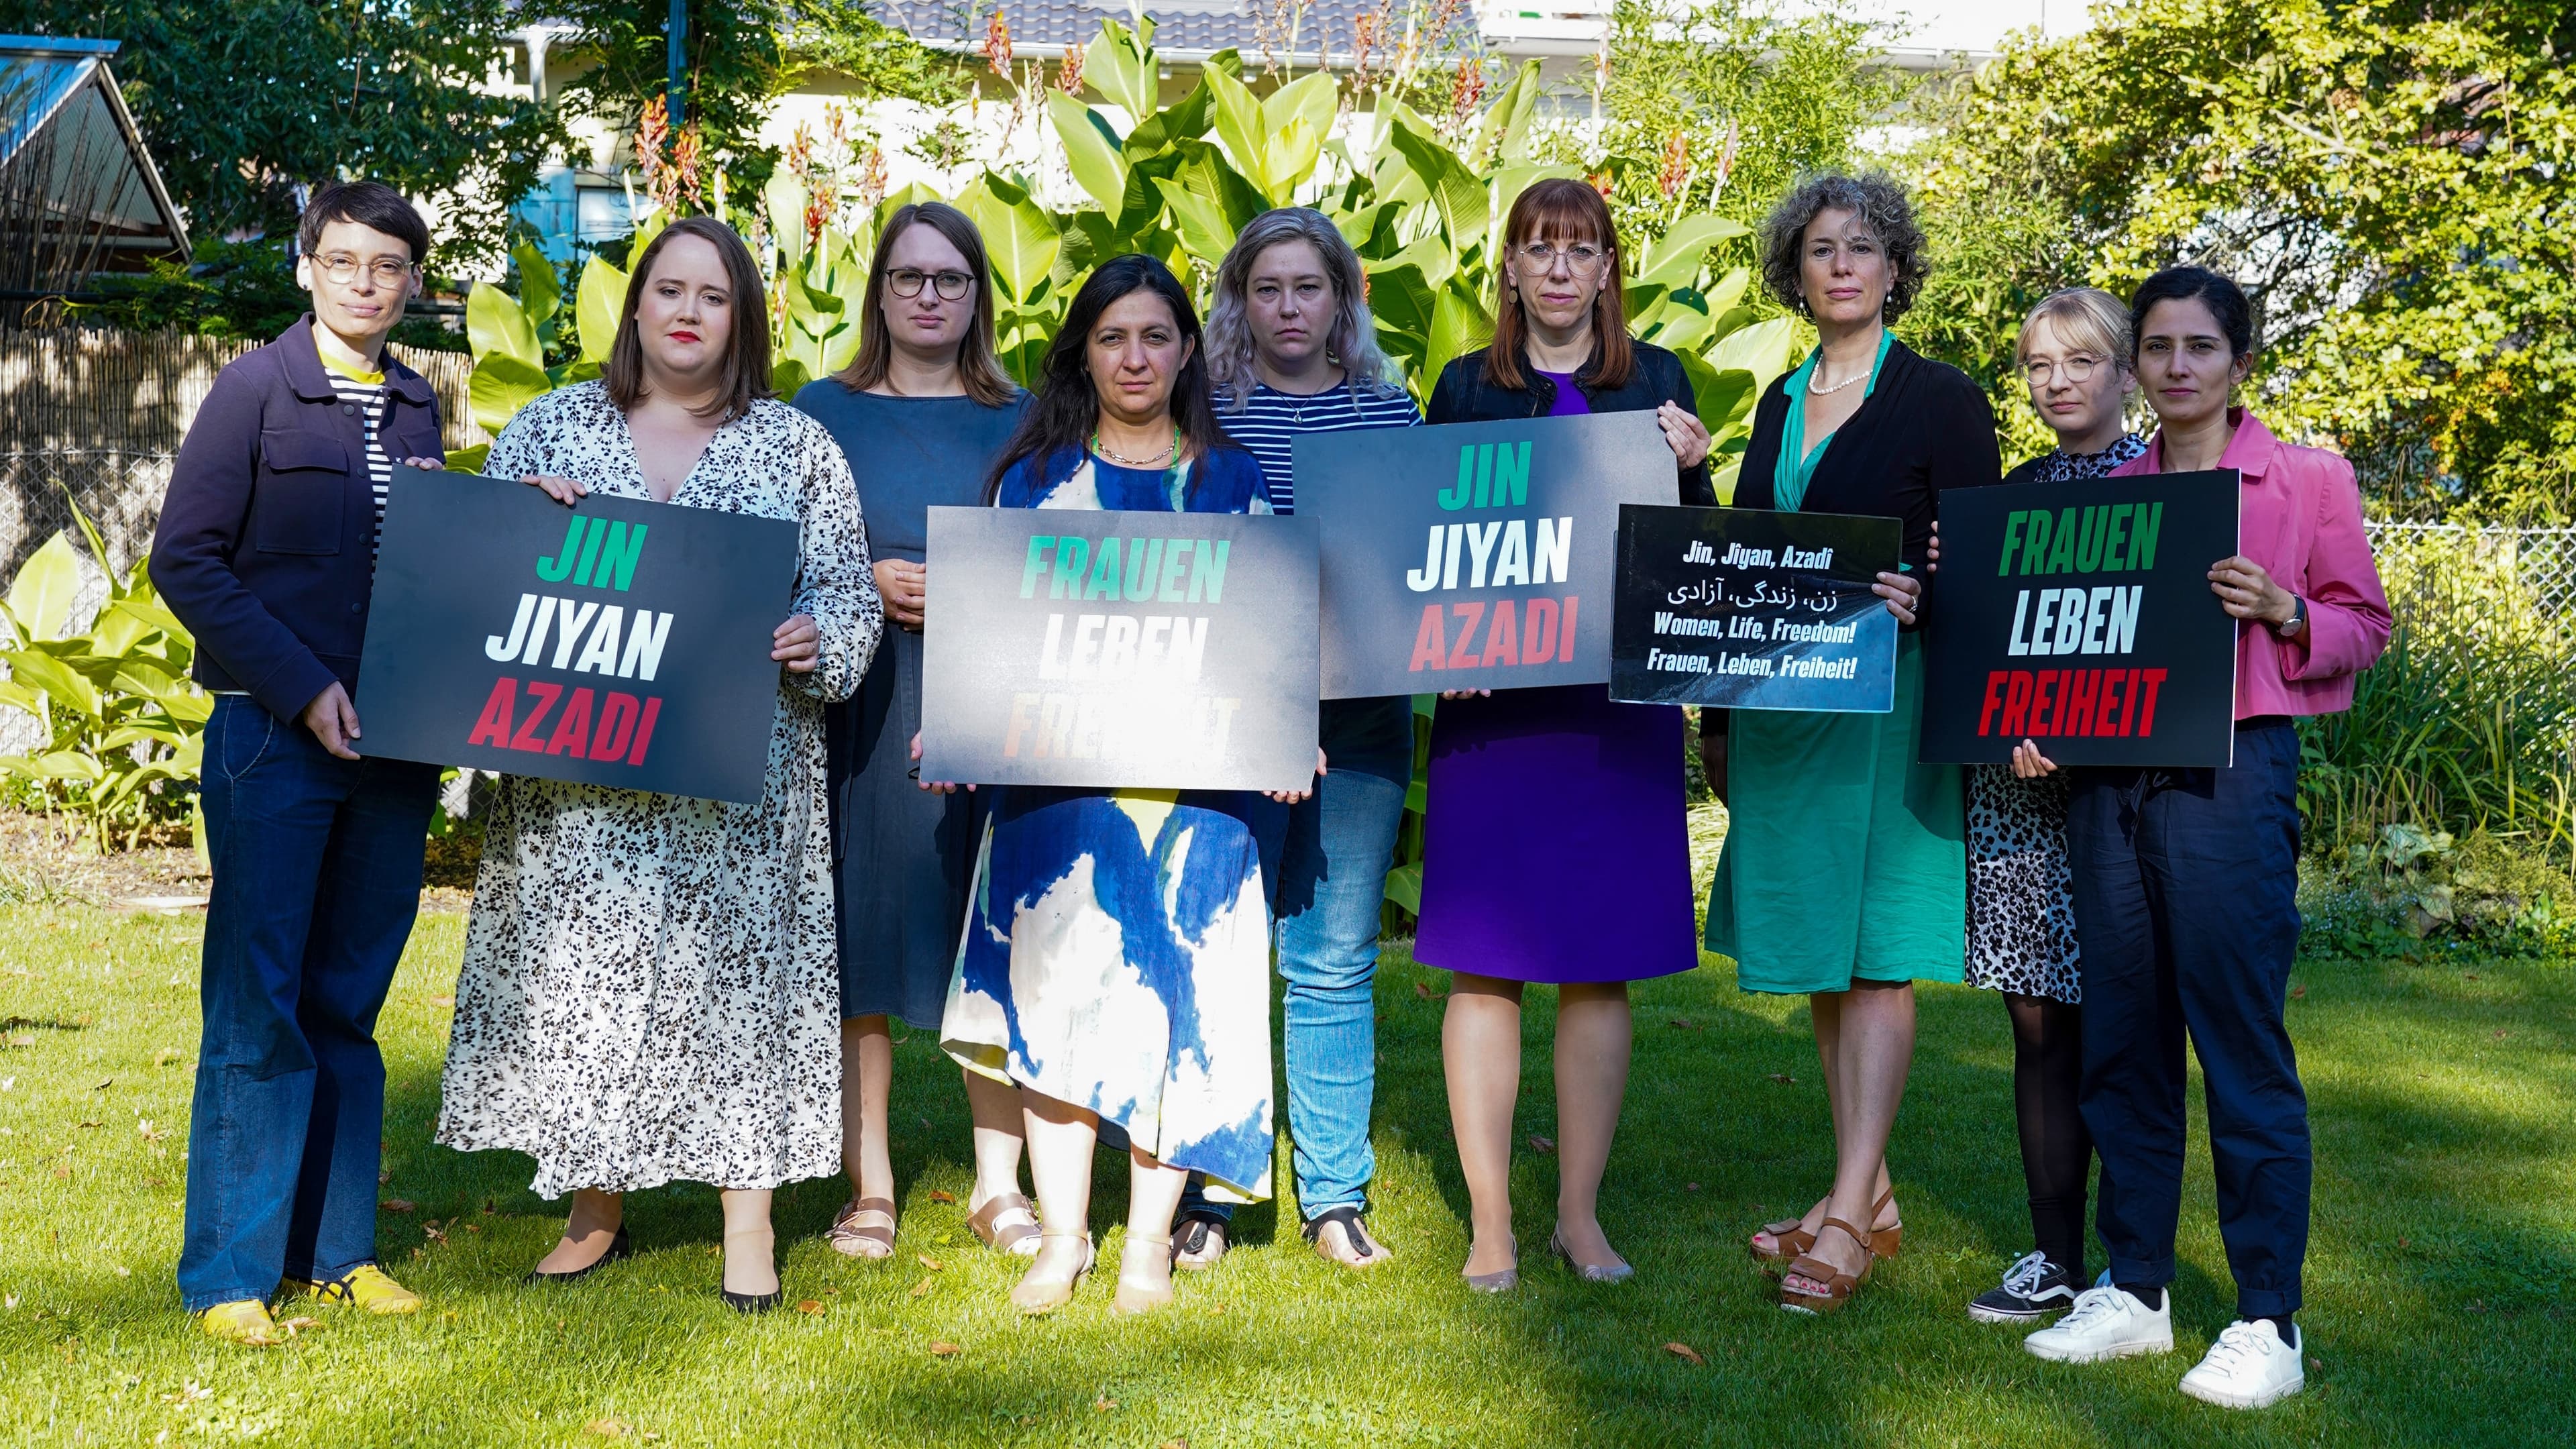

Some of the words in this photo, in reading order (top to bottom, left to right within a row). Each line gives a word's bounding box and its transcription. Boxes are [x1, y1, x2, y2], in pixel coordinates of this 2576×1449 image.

[1438, 441, 1533, 511] JIN
[537, 515, 648, 592] JIN
[1019, 535, 1231, 604] FRAUEN
[1407, 517, 1573, 592] JIYAN
[1682, 540, 1716, 566] Jin,
[1780, 545, 1834, 570] Azadî
[1998, 502, 2163, 577] FRAUEN
[1668, 577, 1725, 606] آزادی
[1729, 580, 1796, 610] زندگی،
[1803, 590, 1837, 612] زن،
[2007, 585, 2143, 656] LEBEN
[485, 593, 674, 681] JIYAN
[1038, 613, 1209, 681] LEBEN
[1409, 596, 1578, 671] AZADI
[1654, 611, 1723, 640] Women,
[1727, 616, 1766, 642] Life,
[1771, 618, 1858, 643] Freedom!
[1647, 648, 1713, 676] Frauen,
[1717, 651, 1775, 679] Leben,
[1780, 655, 1858, 680] Freiheit!
[468, 677, 662, 766] AZADI
[1977, 667, 2168, 738] FREIHEIT
